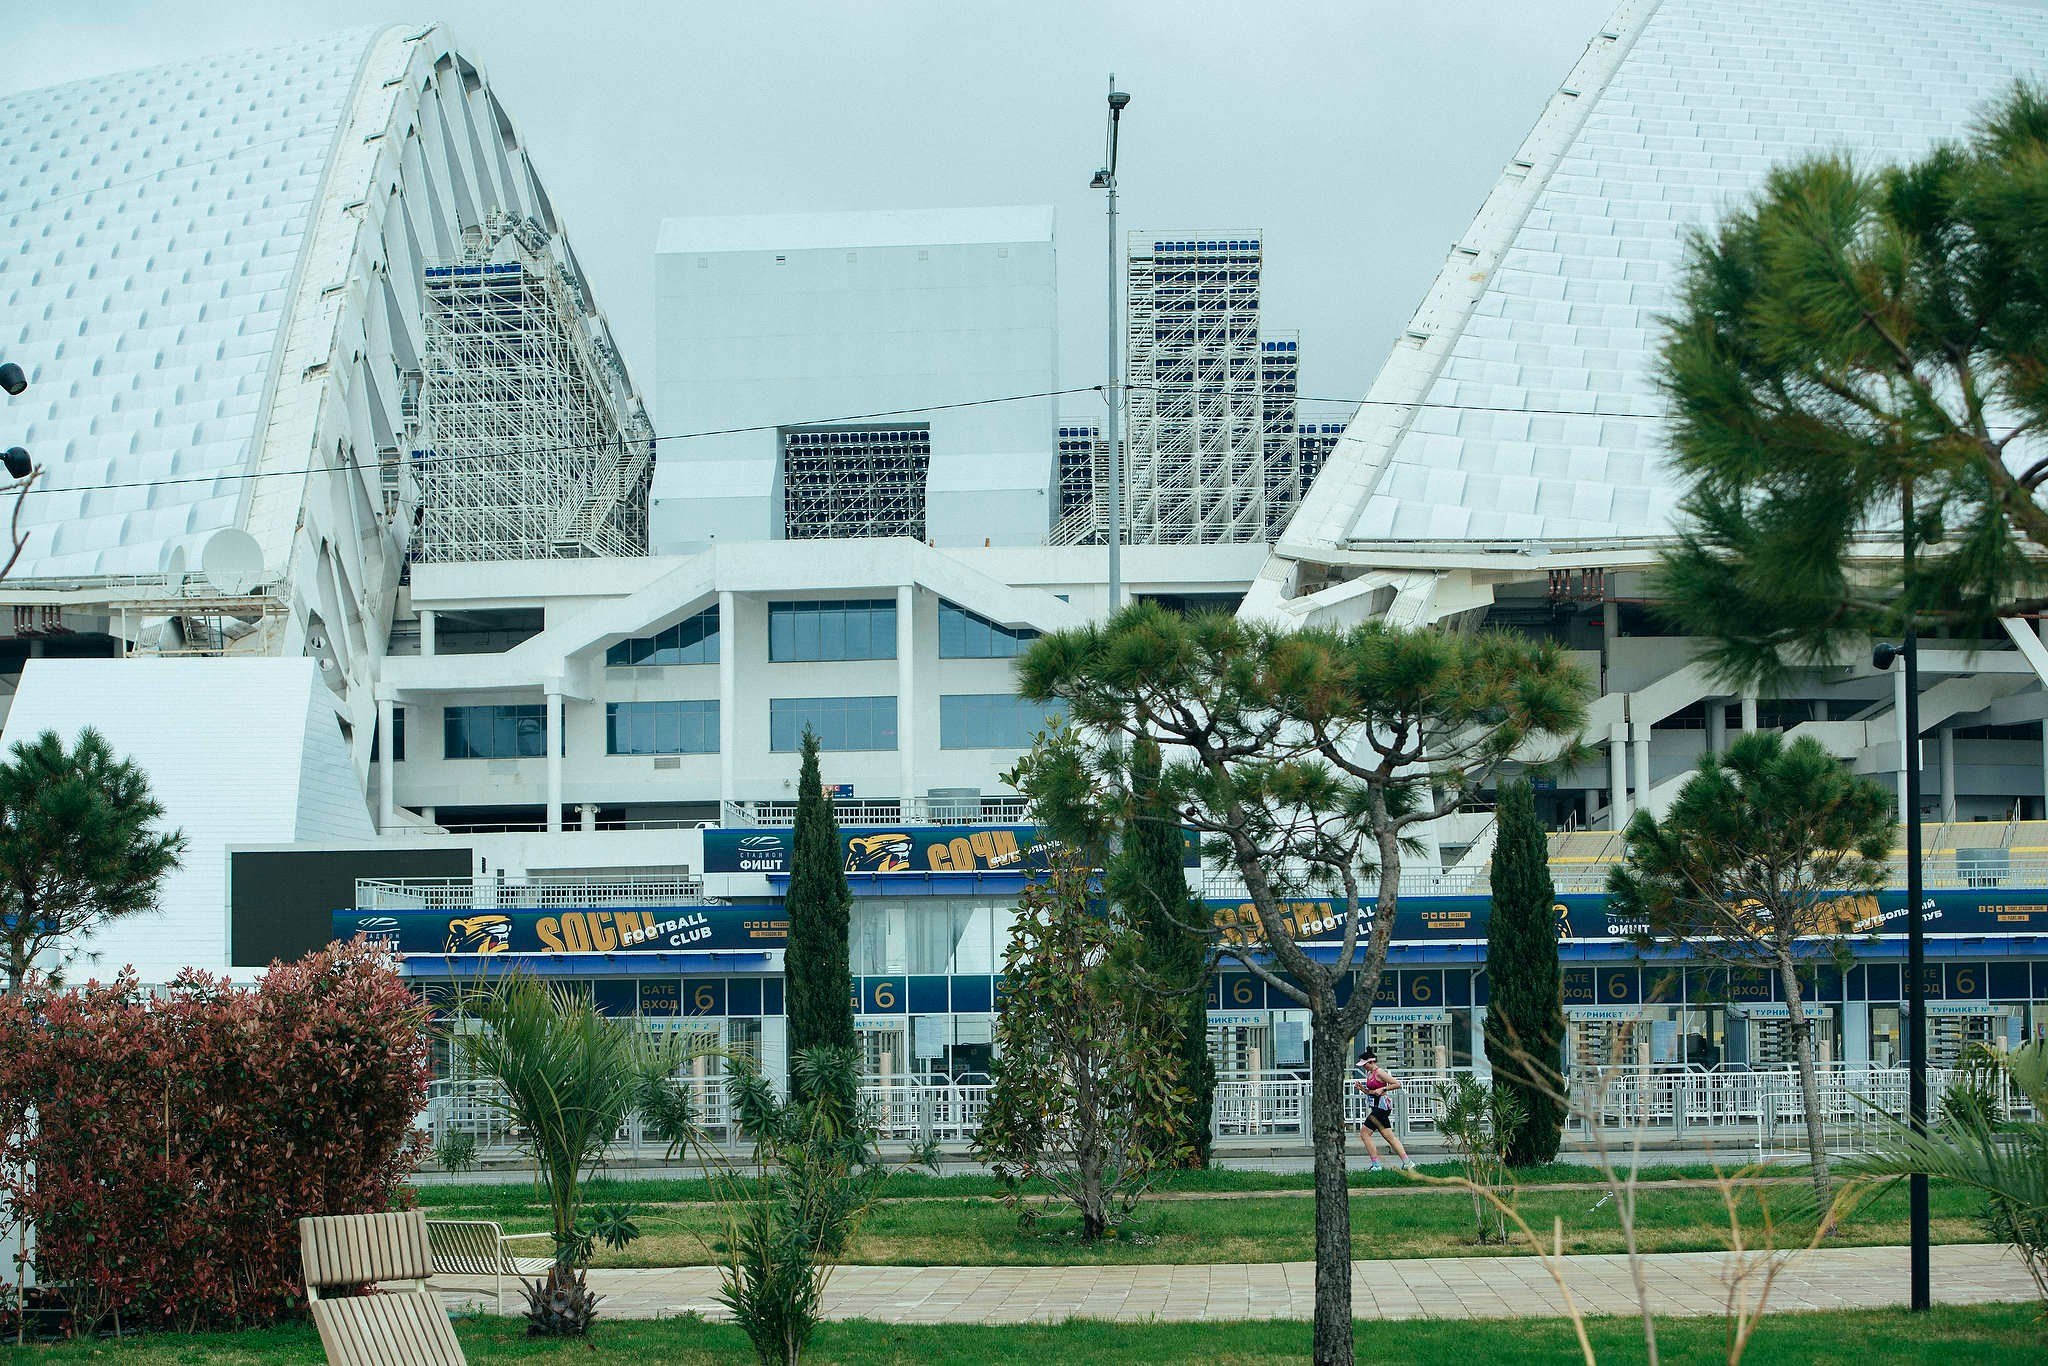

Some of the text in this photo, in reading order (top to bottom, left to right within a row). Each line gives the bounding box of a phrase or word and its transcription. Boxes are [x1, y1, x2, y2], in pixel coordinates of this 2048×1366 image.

[927, 831, 1021, 871] СОЧИ
[740, 859, 783, 870] ФИШТ
[536, 911, 659, 953] SOCHI
[623, 912, 708, 945] FOOTBALL
[669, 926, 712, 947] CLUB
[642, 985, 676, 995] GATE
[1411, 975, 1432, 1001] 6
[1563, 974, 1589, 983] ATE
[1608, 973, 1628, 999] 6
[1956, 969, 1976, 994] 6
[695, 985, 715, 1010] 6
[875, 982, 895, 1008] 6
[1233, 979, 1253, 1004] 6
[1376, 991, 1396, 1002] ОД
[1563, 988, 1593, 999] ХОД
[1733, 986, 1769, 997] ВХОД
[642, 1000, 679, 1010] ВХОД
[1208, 1016, 1239, 1024] НИКЕТ
